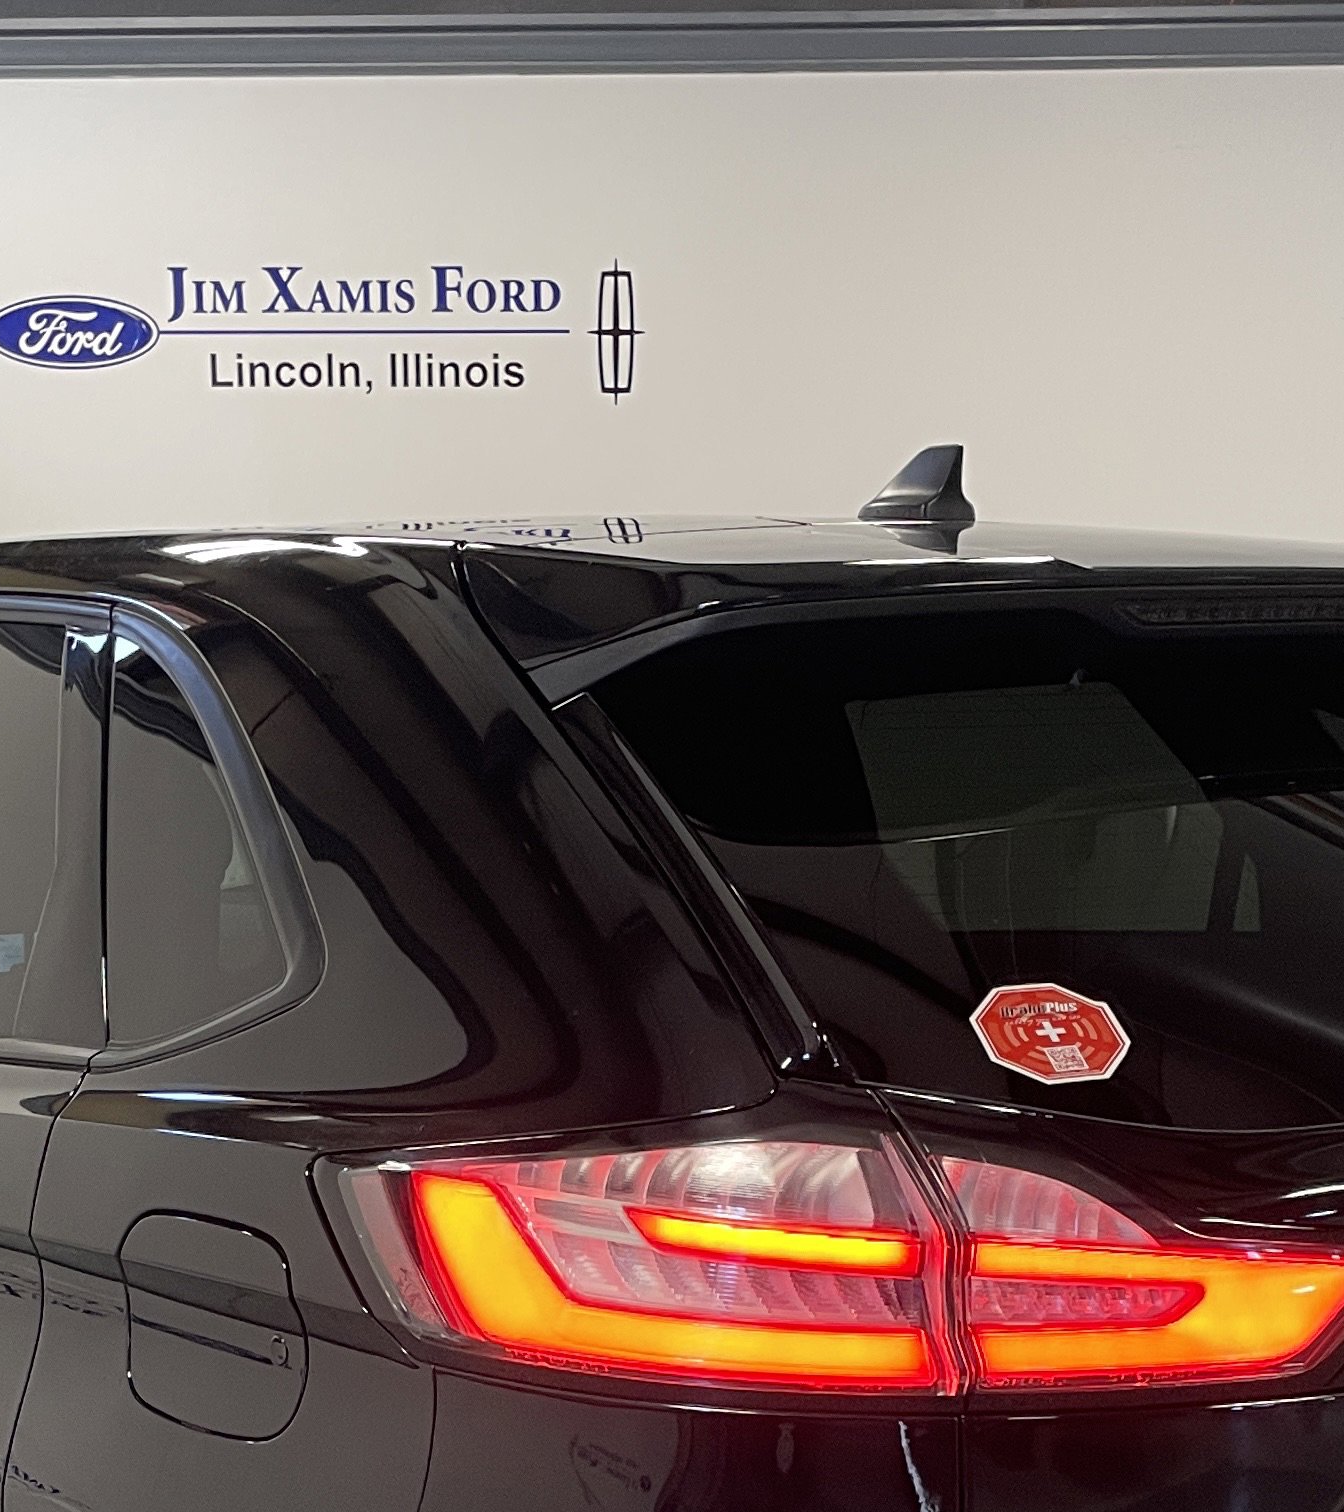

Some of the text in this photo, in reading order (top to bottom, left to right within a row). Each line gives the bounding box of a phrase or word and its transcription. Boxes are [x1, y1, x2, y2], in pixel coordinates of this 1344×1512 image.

[166, 265, 561, 323] JIM XAMIS FORD
[18, 309, 124, 357] Ford
[210, 353, 525, 394] Lincoln, Illinois
